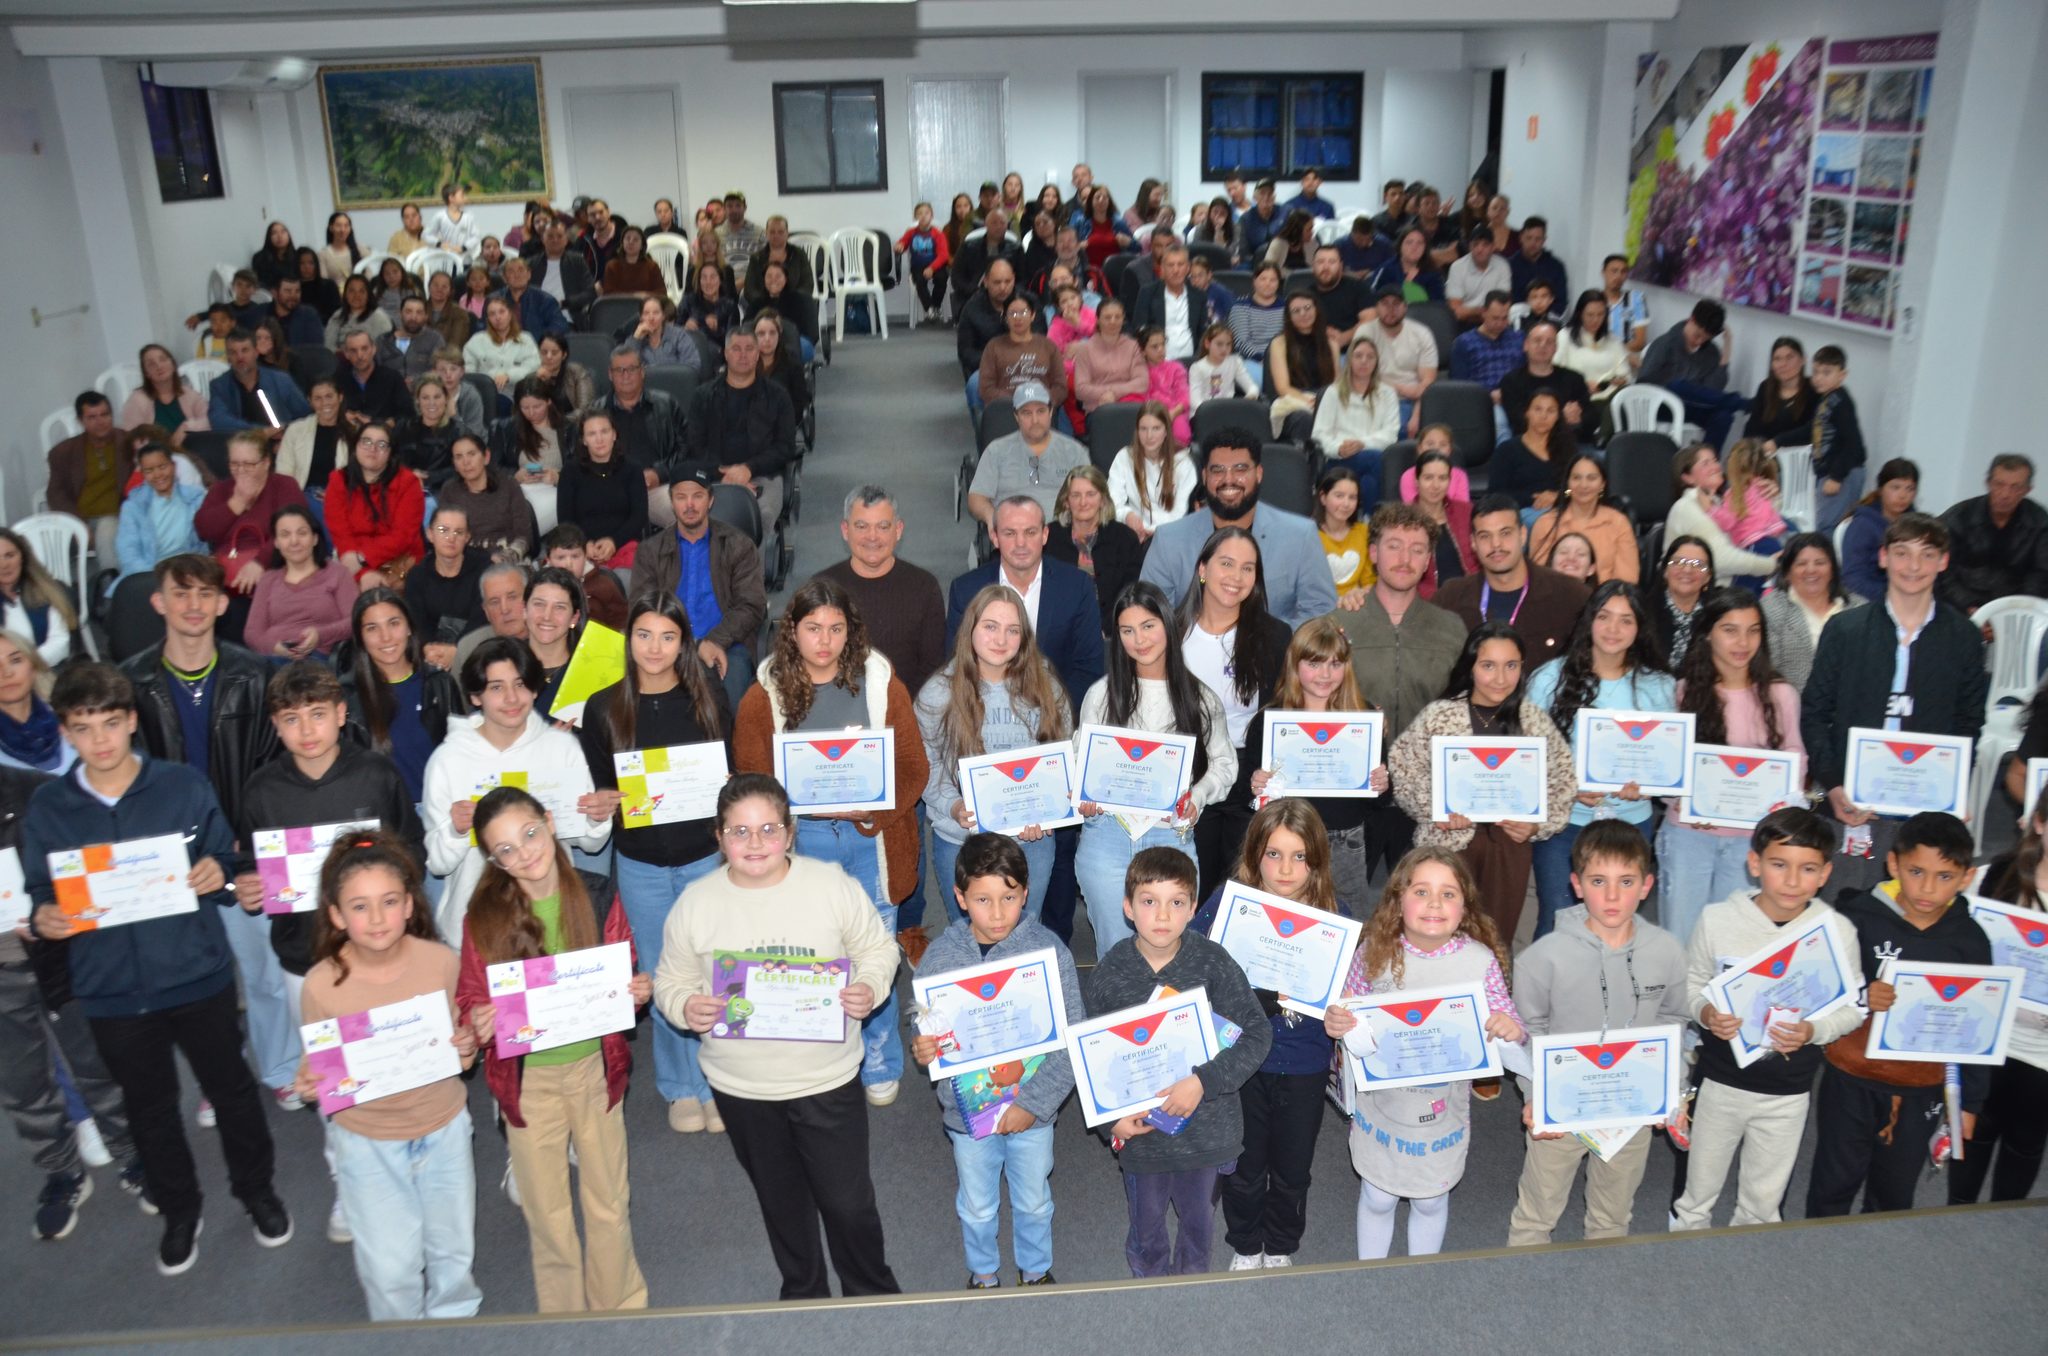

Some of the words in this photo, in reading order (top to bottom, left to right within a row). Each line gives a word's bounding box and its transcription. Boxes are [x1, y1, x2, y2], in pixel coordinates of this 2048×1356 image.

[1115, 762, 1153, 773] CERTIFICATE
[1002, 782, 1040, 794] CERTIFICATE
[1321, 928, 1336, 939] KNN
[1259, 935, 1304, 954] CERTIFICATE
[755, 972, 837, 986] CERTIFICATE
[1022, 971, 1036, 979] KNN
[968, 1000, 1014, 1016] CERTIFICATE
[1174, 1012, 1189, 1022] KNN
[1394, 1027, 1441, 1039] CERTIFICATE
[1122, 1043, 1168, 1061] CERTIFICATE
[1582, 1071, 1630, 1081] CERTIFICATE
[1354, 1109, 1373, 1135] EW
[1376, 1127, 1391, 1148] IN
[1395, 1137, 1427, 1157] THE
[1431, 1126, 1465, 1153] CREW
